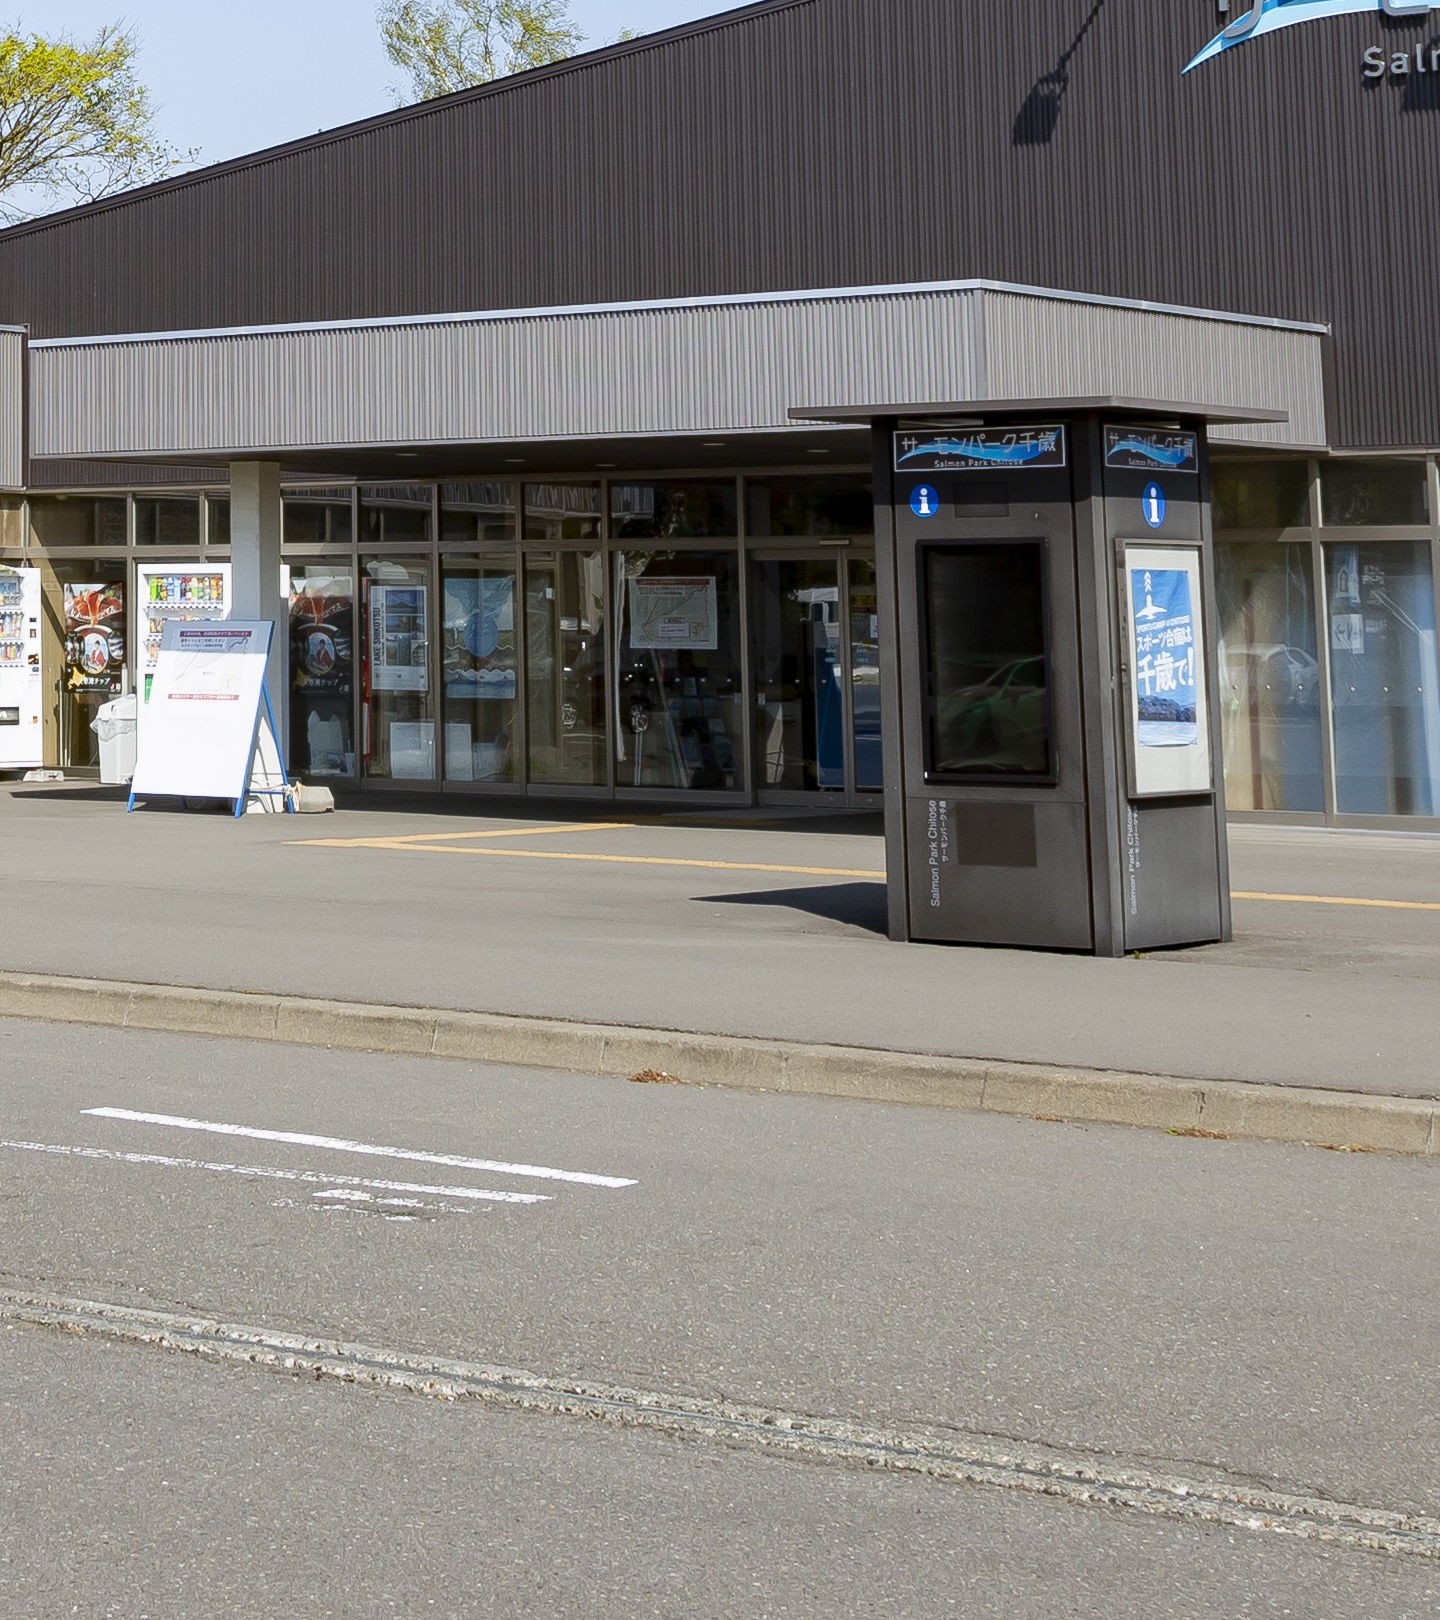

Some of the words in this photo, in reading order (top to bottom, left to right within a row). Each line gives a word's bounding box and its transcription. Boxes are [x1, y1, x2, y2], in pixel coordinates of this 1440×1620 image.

[901, 431, 1057, 456] サーモンパーク千歳
[934, 460, 966, 468] Salmon
[968, 459, 988, 467] Park
[1136, 626, 1193, 652] スポーツ合宿は
[373, 646, 382, 666] LAKE
[928, 841, 939, 866] Park
[930, 867, 941, 907] Salmon
